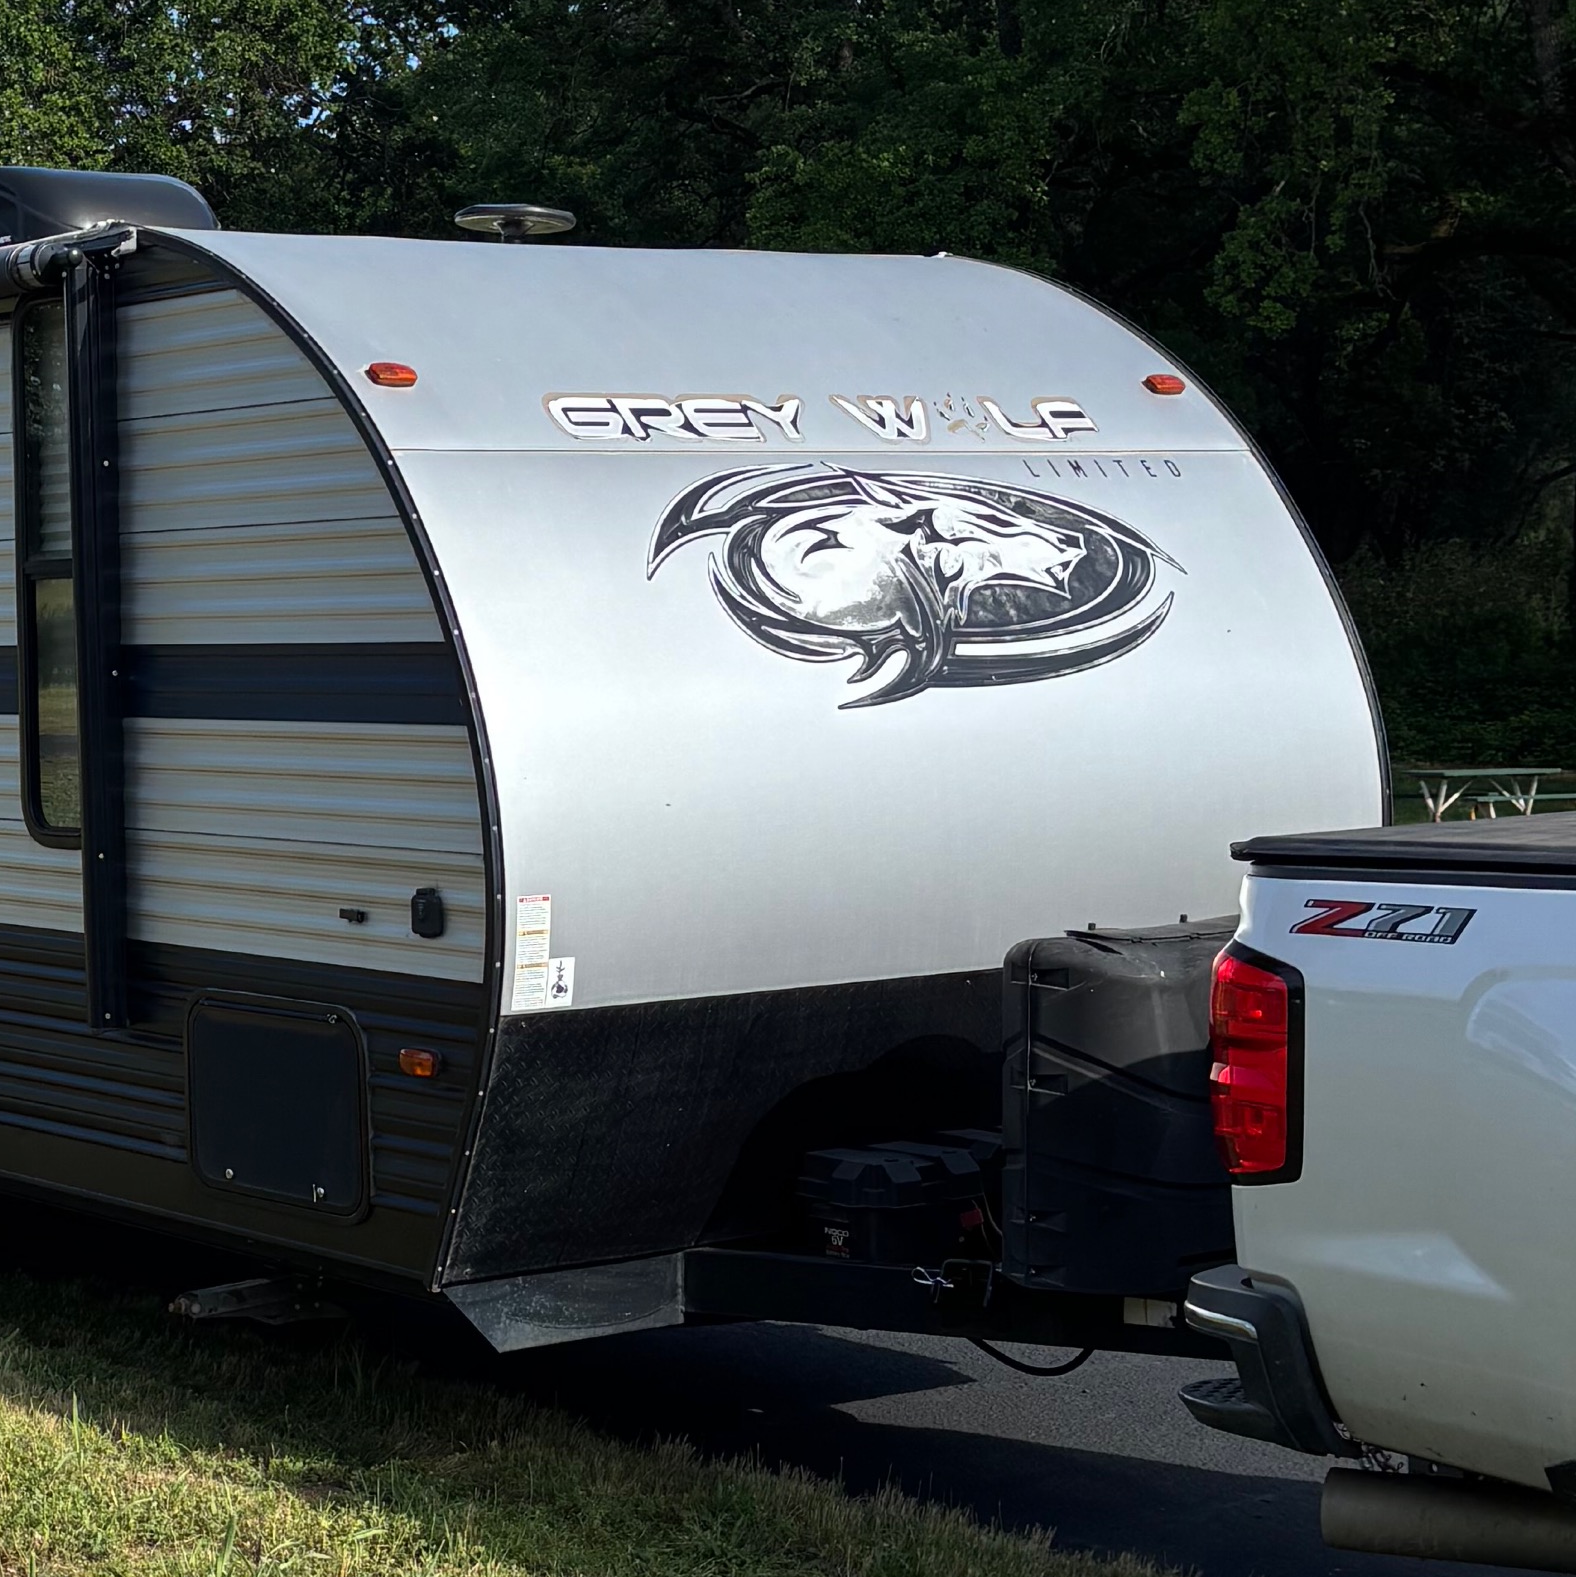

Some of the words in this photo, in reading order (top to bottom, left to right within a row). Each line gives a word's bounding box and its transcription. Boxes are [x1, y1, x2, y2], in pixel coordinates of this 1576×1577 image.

[544, 394, 804, 442] GREY
[1022, 458, 1182, 479] LIMITED
[1289, 898, 1478, 943] Z71
[1364, 931, 1397, 940] OFF
[1402, 933, 1453, 943] ROAD
[824, 1226, 850, 1237] NOCO
[831, 1235, 844, 1245] 6V
